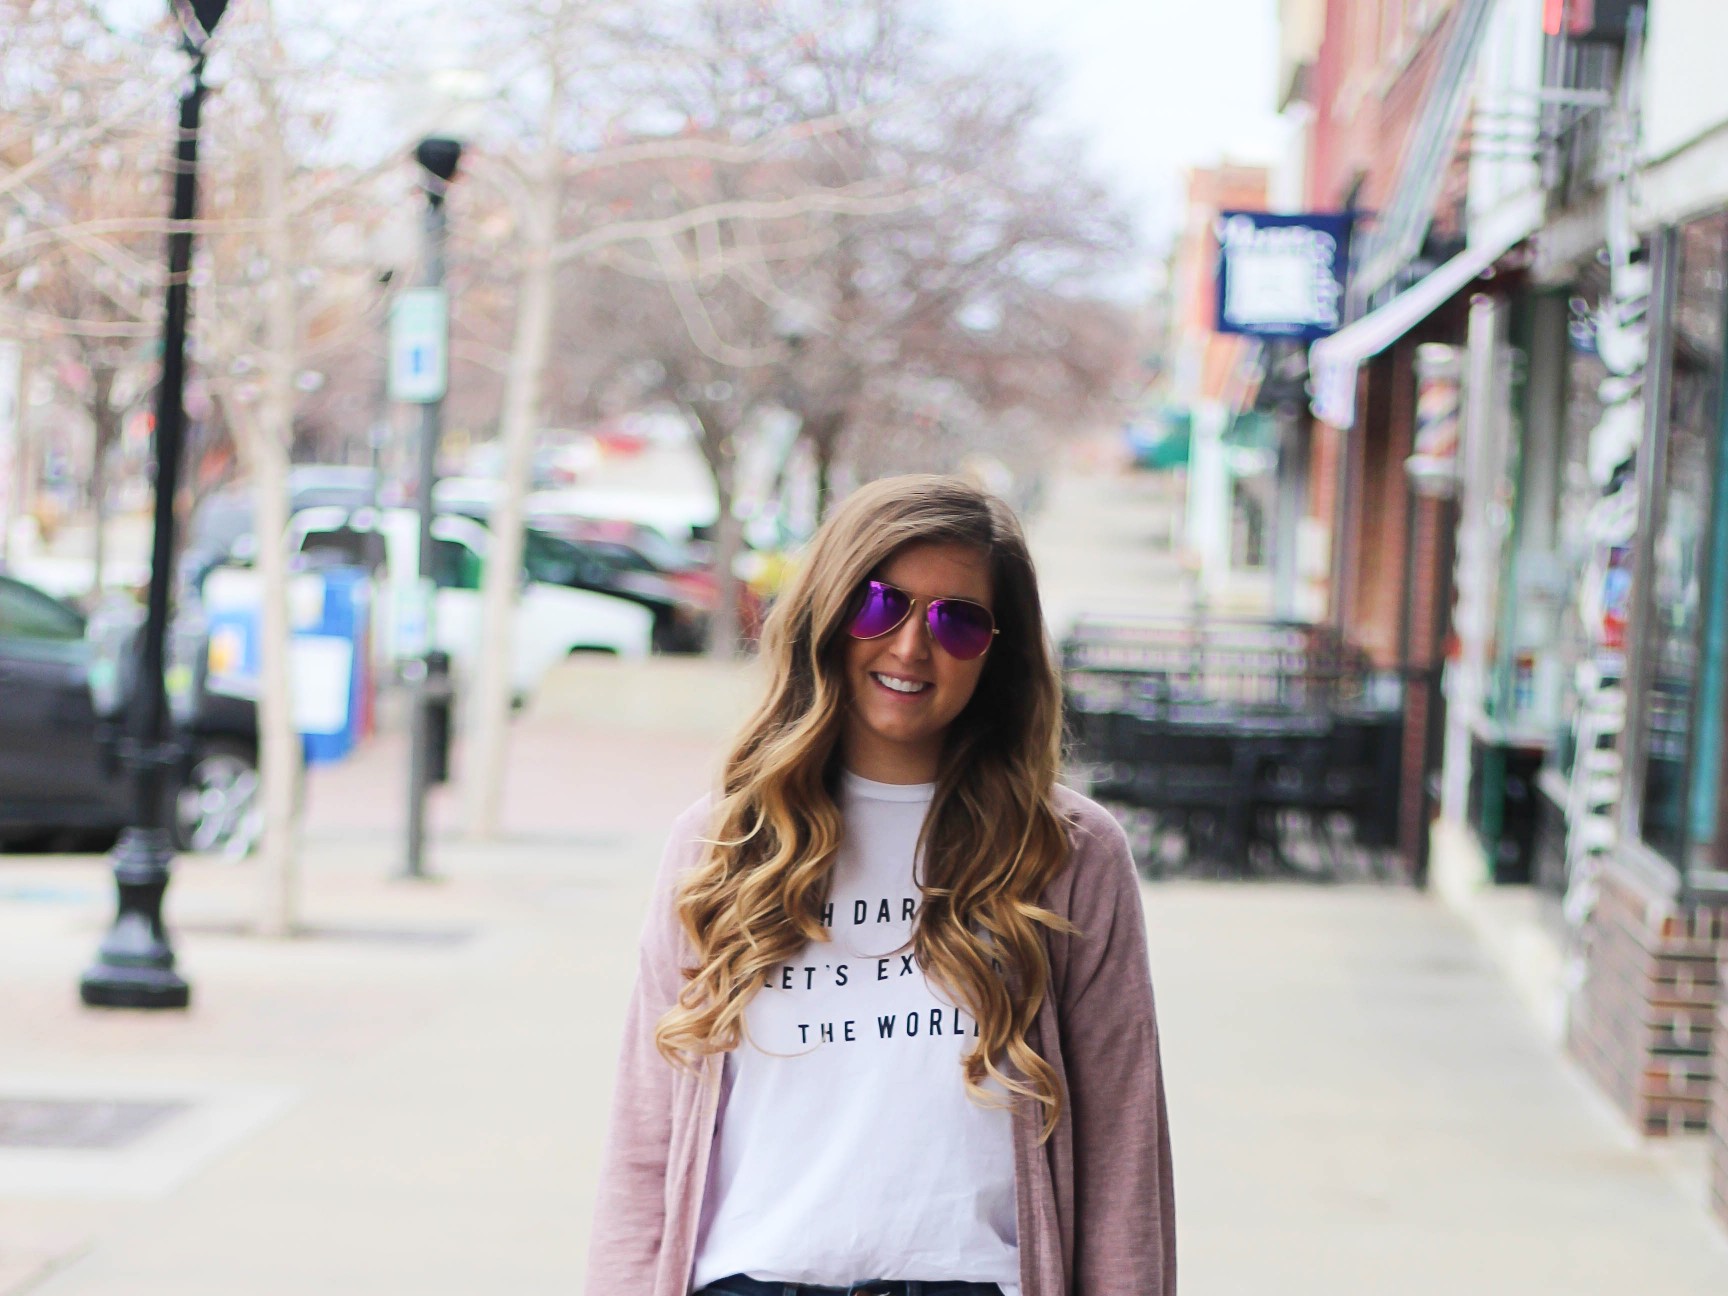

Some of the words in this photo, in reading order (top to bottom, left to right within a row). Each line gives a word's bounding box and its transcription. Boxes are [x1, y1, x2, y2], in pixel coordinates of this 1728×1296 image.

[820, 902, 834, 927] H
[854, 897, 915, 925] DAR
[764, 964, 849, 990] ET'S
[877, 953, 914, 981] EX
[798, 1020, 856, 1043] THE
